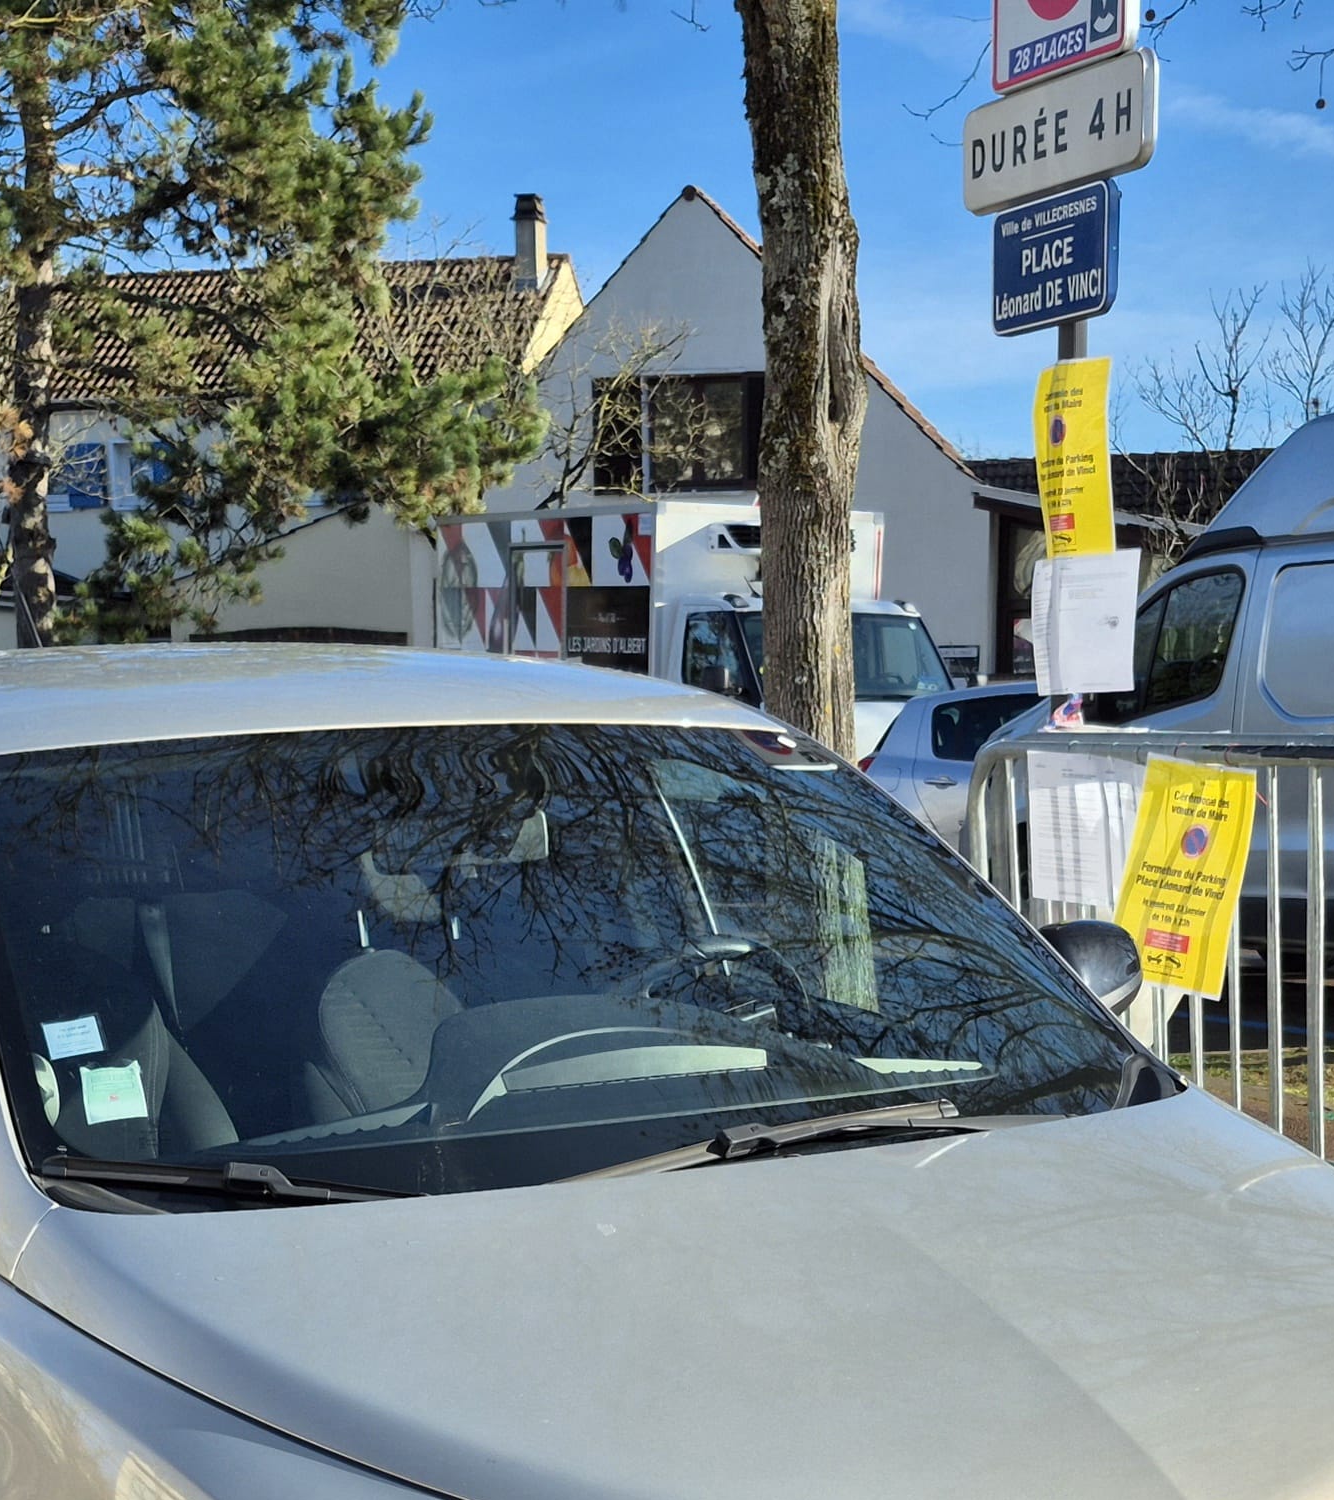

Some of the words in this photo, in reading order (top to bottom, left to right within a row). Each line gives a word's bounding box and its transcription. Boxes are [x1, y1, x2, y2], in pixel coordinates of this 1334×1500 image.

[1013, 49, 1030, 75] 28
[1033, 27, 1084, 66] PLACES
[971, 108, 1068, 180] DURÉE
[1001, 221, 1019, 237] Ville
[1021, 218, 1032, 232] de
[1034, 197, 1097, 227] VILLECRESNES
[1021, 236, 1074, 276] PLACE
[995, 286, 1042, 321] Léonard
[1046, 278, 1063, 308] DE
[1067, 267, 1102, 300] VINCI
[1066, 454, 1093, 465] Parking
[1077, 464, 1095, 476] Vinci
[568, 636, 581, 652] LES
[583, 637, 611, 653] JARDINS
[612, 637, 646, 654] D'ALBERT
[1136, 874, 1158, 888] Place
[1159, 879, 1192, 894] Léonard
[1192, 886, 1203, 896] de
[1204, 888, 1225, 900] Vinci
[1141, 861, 1182, 877] Fermeture
[1184, 869, 1194, 880] du
[1195, 871, 1227, 888] Parking
